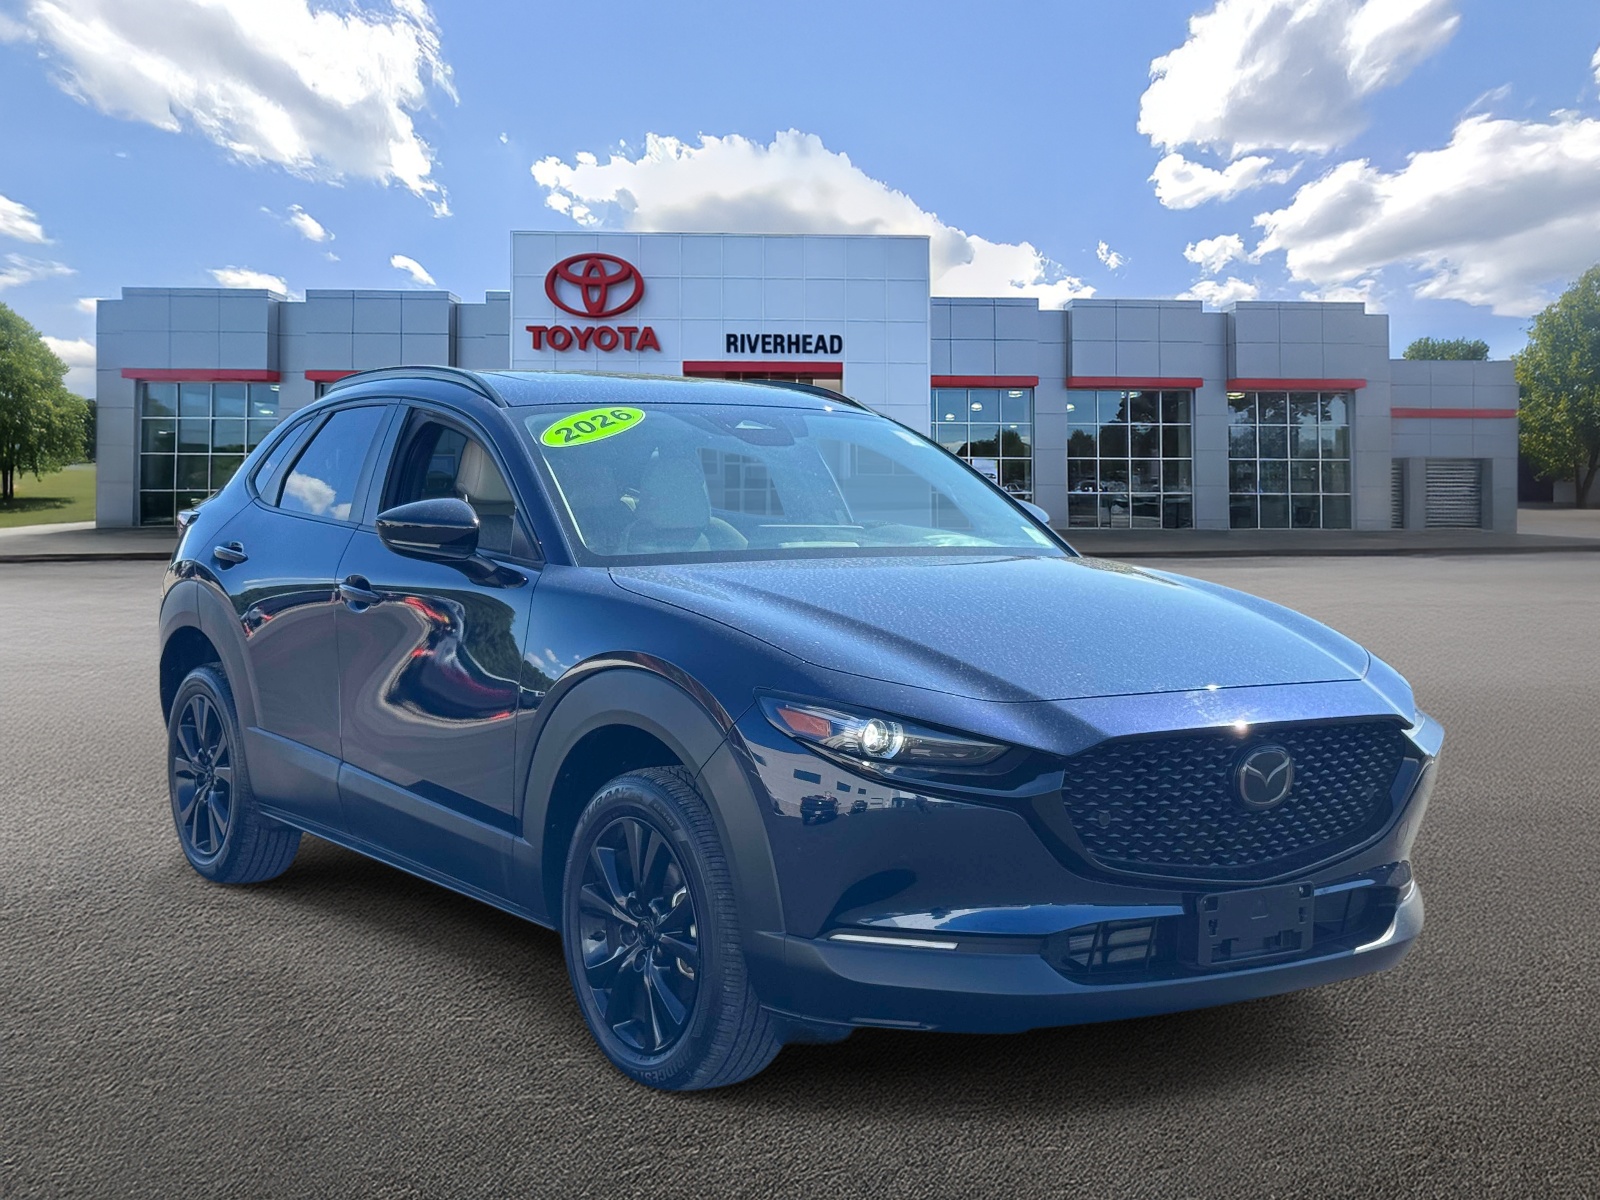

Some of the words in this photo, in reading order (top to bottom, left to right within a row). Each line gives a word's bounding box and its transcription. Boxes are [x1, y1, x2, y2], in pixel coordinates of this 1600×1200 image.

[526, 325, 661, 352] TOYOTA
[726, 333, 844, 355] RIVERHEAD
[554, 409, 633, 443] 2026
